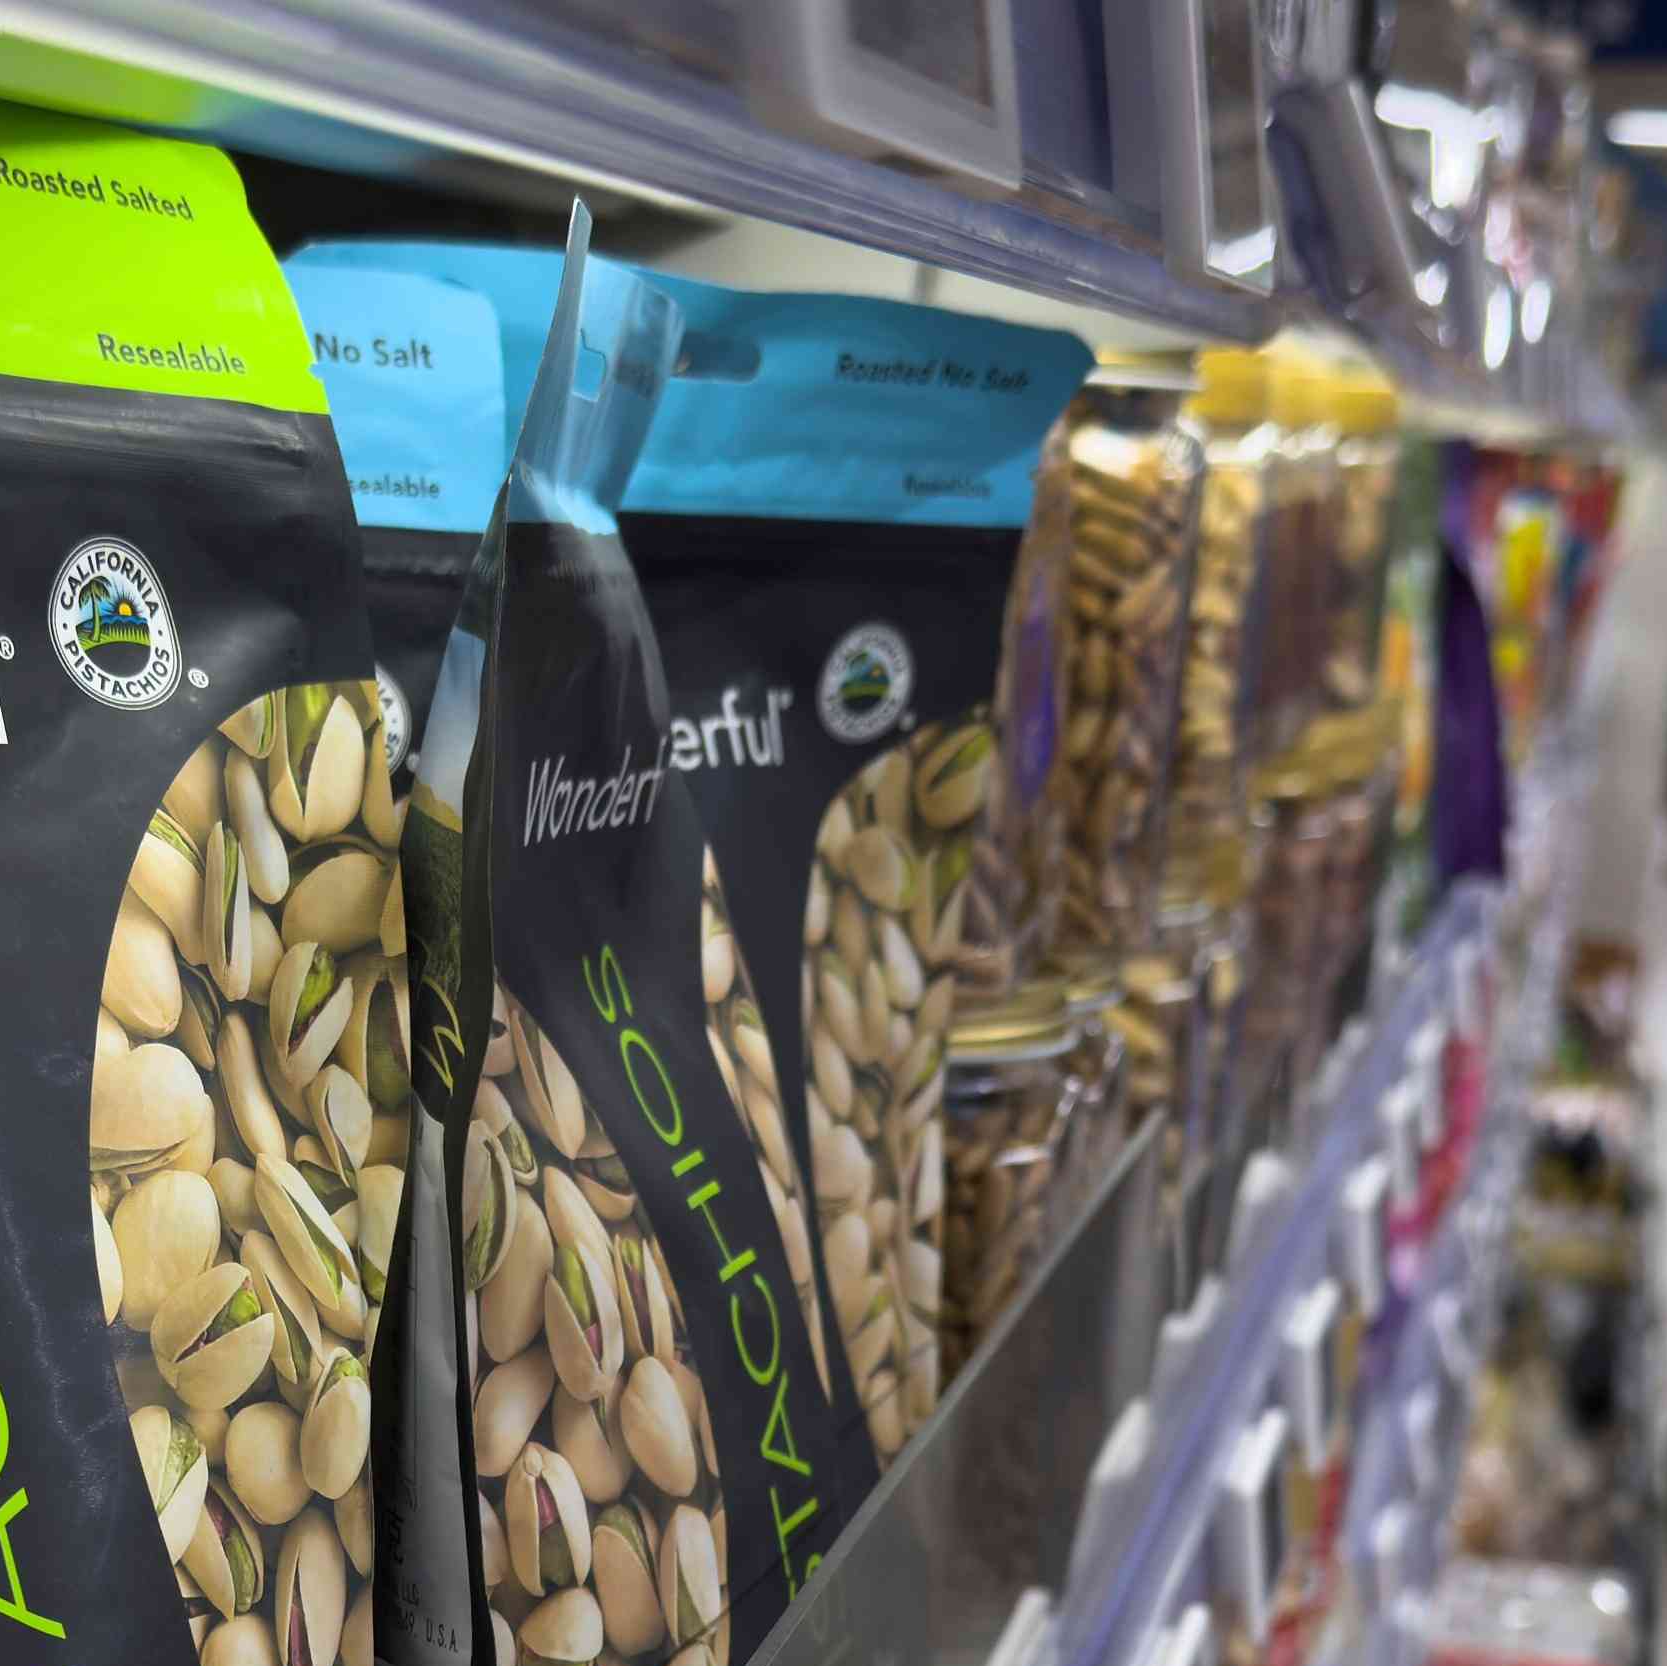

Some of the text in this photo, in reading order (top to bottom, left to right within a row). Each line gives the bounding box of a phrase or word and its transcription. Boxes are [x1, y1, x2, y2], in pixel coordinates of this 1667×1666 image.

[109, 179, 194, 222] Salted
[96, 332, 247, 376] Resealable
[313, 332, 434, 369] No Salt
[60, 551, 160, 619] CALIFORNIA
[64, 646, 171, 699] PISTACHIOS
